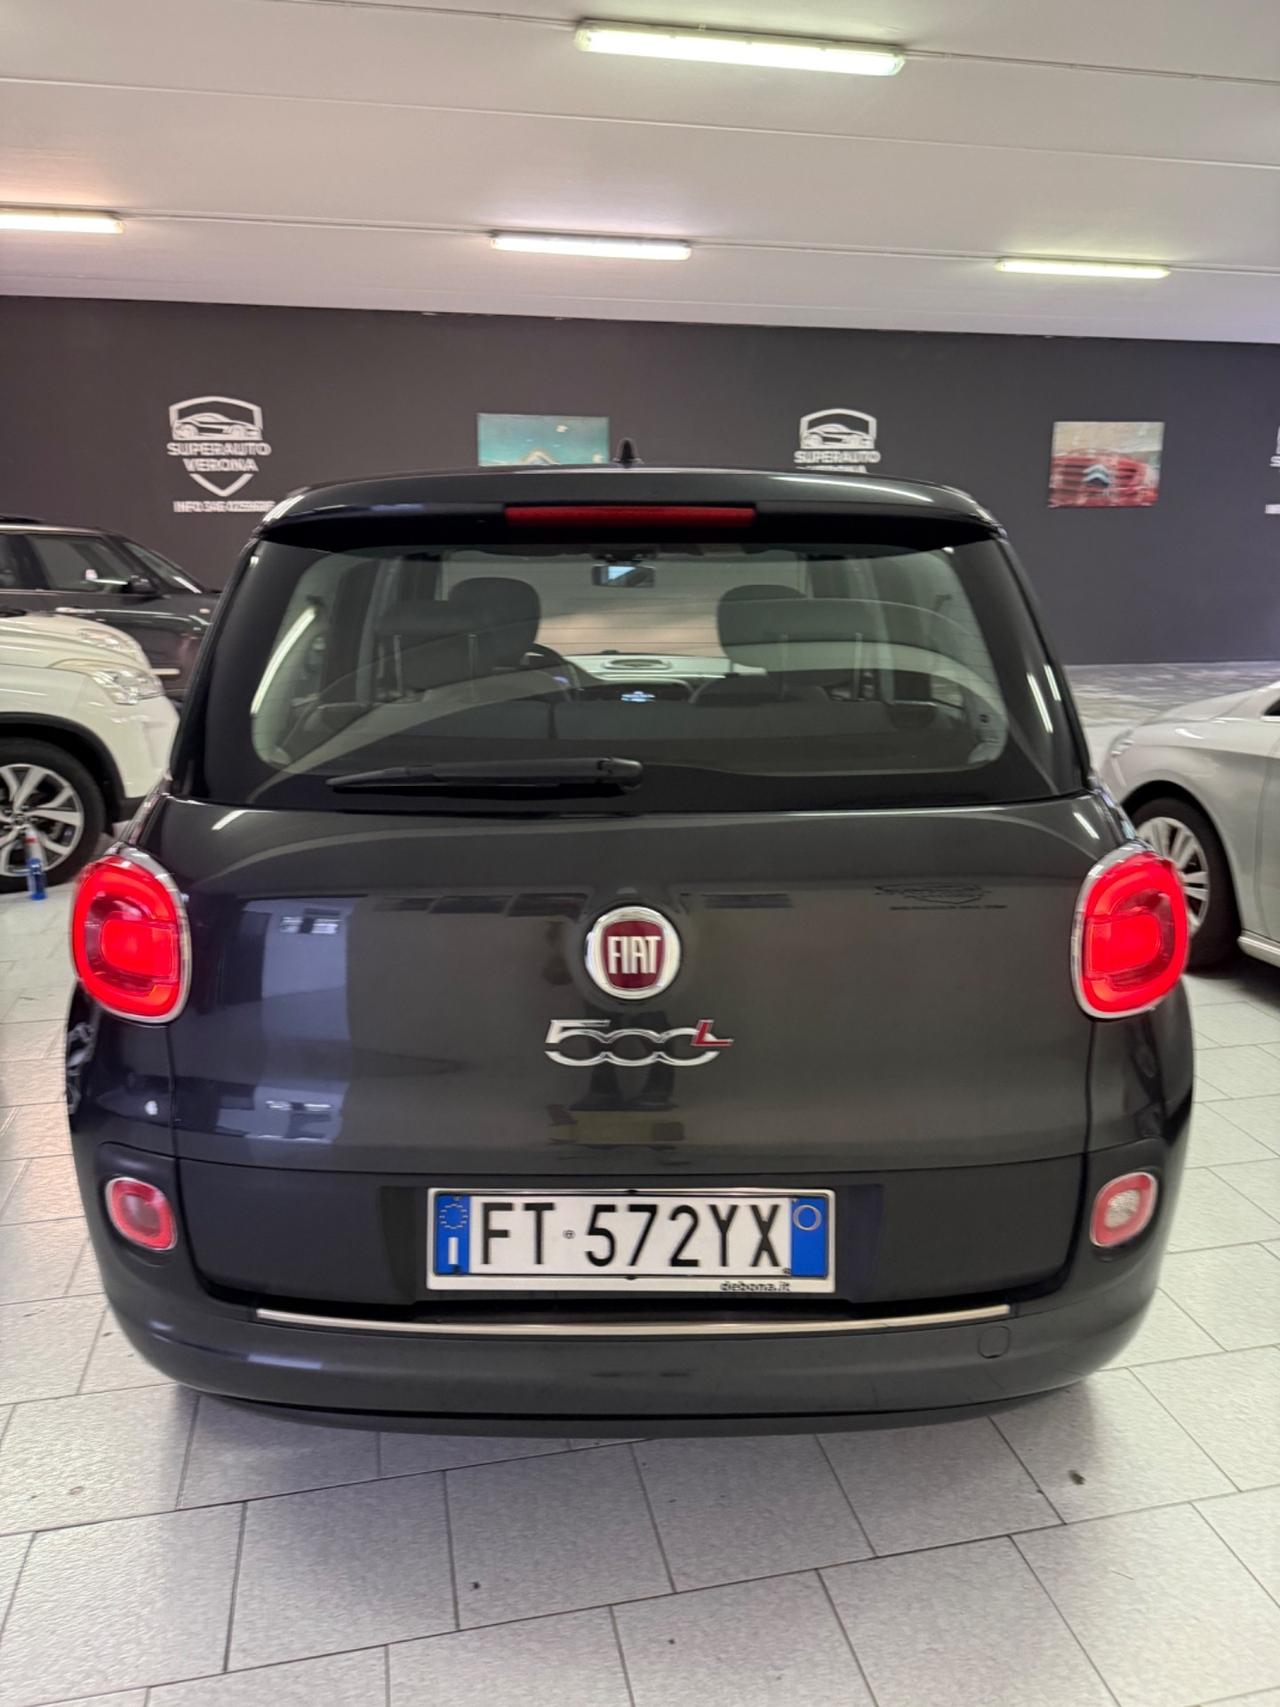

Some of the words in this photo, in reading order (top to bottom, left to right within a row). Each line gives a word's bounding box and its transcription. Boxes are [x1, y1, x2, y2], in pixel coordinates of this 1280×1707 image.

[166, 442, 272, 456] SUPERAUTO
[793, 450, 881, 463] SUPERAUTO
[182, 458, 259, 472] VERONA
[607, 935, 661, 974] FIAT
[544, 1019, 734, 1067] 500L
[481, 1202, 555, 1265] FT
[585, 1203, 782, 1268] 572YX
[720, 1281, 791, 1292] debona.it
